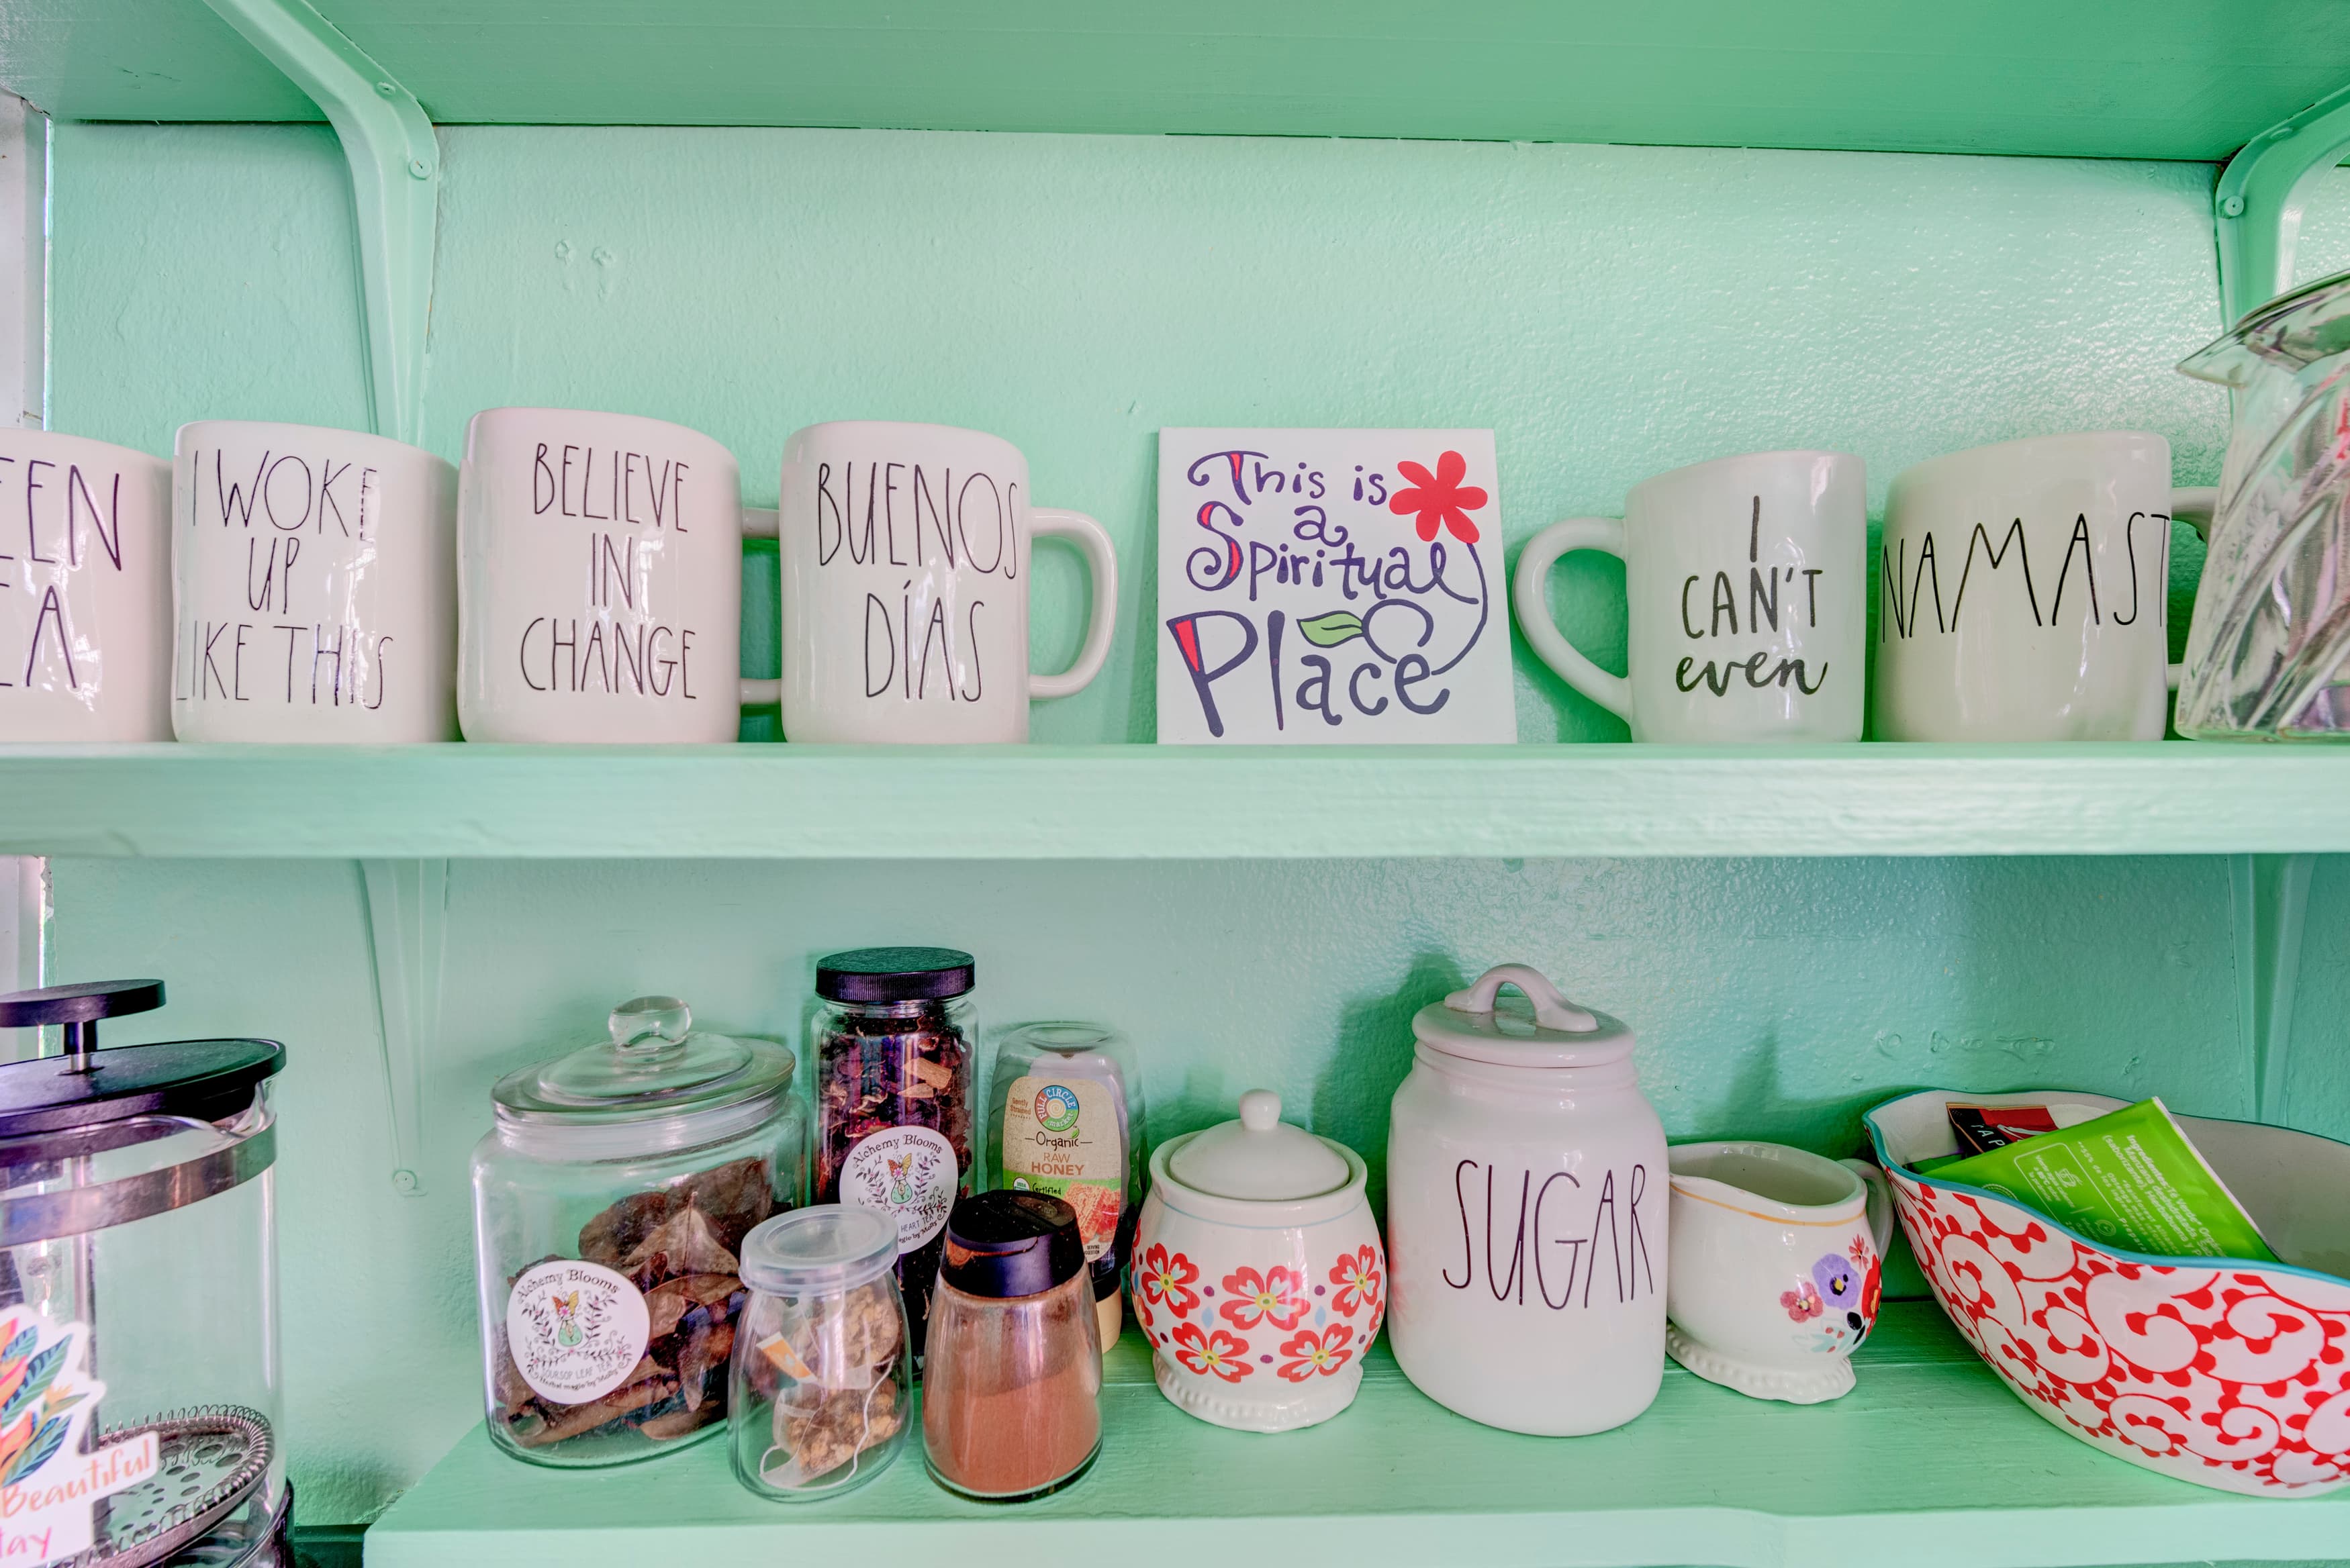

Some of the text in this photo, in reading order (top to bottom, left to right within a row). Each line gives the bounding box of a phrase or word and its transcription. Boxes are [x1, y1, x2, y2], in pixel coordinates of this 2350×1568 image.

[193, 448, 378, 542] I WOKE
[533, 442, 690, 532] BELIEVE
[1187, 450, 1388, 505] This is
[0, 457, 122, 571] EN
[818, 461, 1018, 579] BUENOS
[1292, 505, 1349, 548] a
[1749, 495, 1760, 563] I
[248, 537, 300, 614] UP
[592, 532, 632, 609] IN
[1185, 500, 1480, 601] Spiritual
[0, 583, 77, 689] A
[1681, 567, 1824, 640] CAN'T
[273, 624, 394, 710] THIS
[520, 617, 697, 699] CHANGE
[865, 579, 984, 703] DÍAS
[1166, 609, 1451, 738] Place
[1675, 651, 1829, 697] even
[1010, 1105, 1031, 1116] Strained
[1012, 1097, 1029, 1108] Gently
[1037, 1087, 1076, 1120] FULL CIRCLE
[853, 1134, 943, 1168] Alchemy Blooms
[1031, 1161, 1085, 1175] HONEY
[1035, 1130, 1079, 1152] Organic
[1043, 1152, 1070, 1163] RAW
[900, 1214, 934, 1233] HEART TEA
[1032, 1183, 1062, 1195] Certified
[1442, 1159, 1654, 1310] SUGAR
[517, 1268, 620, 1304] Alchemy Blooms
[0, 1438, 151, 1519] Beautiful
[0, 1525, 53, 1560] ay
